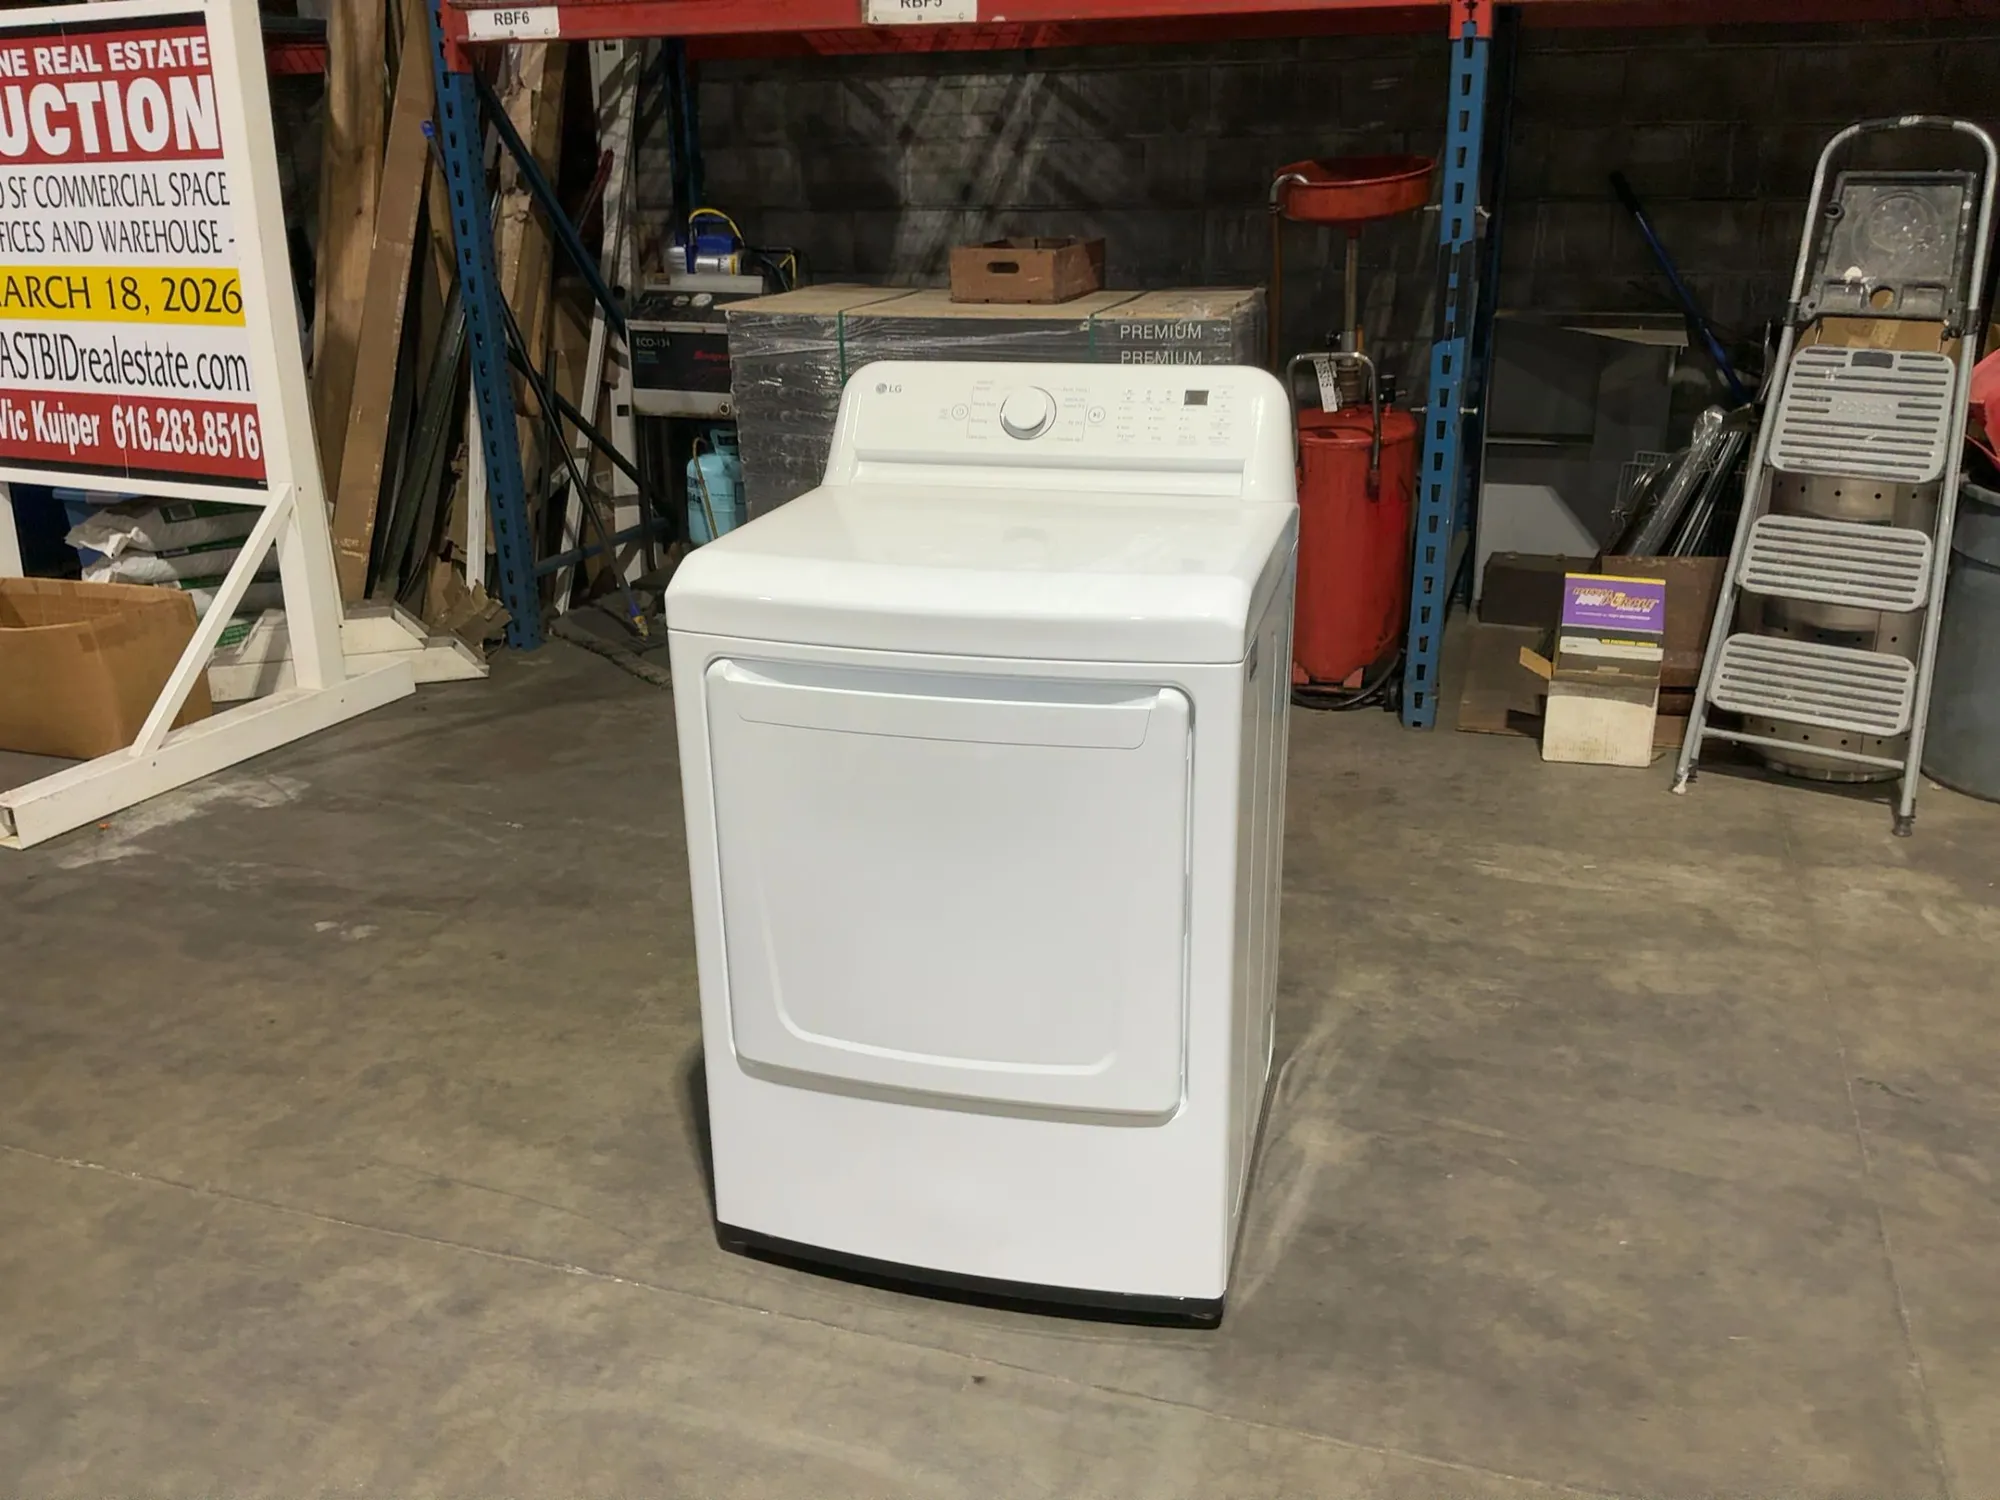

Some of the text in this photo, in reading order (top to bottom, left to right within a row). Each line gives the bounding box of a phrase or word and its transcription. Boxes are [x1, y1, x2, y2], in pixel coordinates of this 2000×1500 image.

[493, 11, 530, 26] RBF6
[34, 44, 103, 76] REAL
[107, 36, 209, 71] ESTATE
[0, 74, 220, 157] UCTION
[8, 176, 27, 209] SF
[33, 173, 165, 209] COMMERCIAL
[168, 171, 230, 208] SPACE
[52, 221, 94, 253] AND
[97, 219, 222, 254] WAREHOUSE
[0, 274, 243, 316] ARCH 18, 2026
[1120, 324, 1202, 340] PREMIUM
[0, 331, 251, 392] ASTBIDrealestate.com
[1121, 351, 1202, 364] PREMIUM
[31, 400, 100, 455] Kuiper
[111, 404, 260, 461] 616.283.8516
